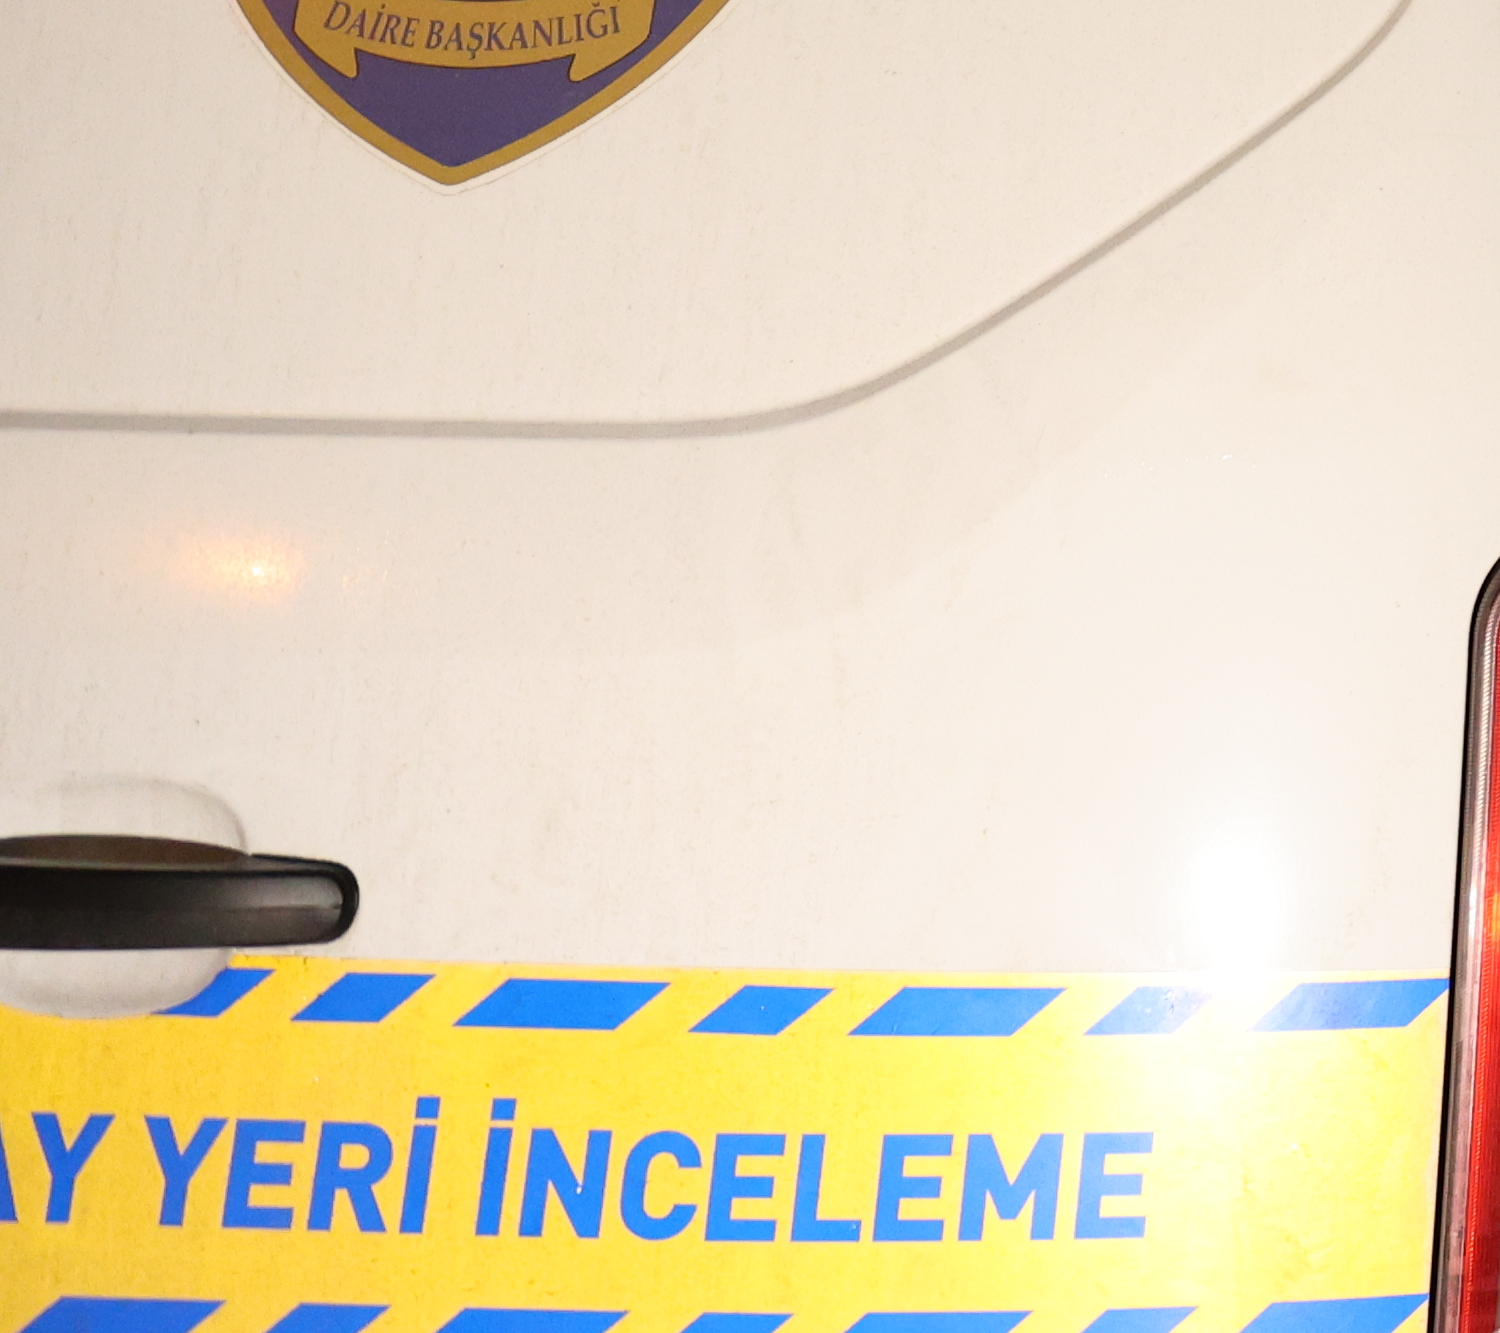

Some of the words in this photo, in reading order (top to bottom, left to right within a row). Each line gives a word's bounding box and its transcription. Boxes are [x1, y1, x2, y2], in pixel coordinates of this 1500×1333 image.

[323, 0, 421, 48] DAİRE
[425, 2, 621, 60] BAŞKANLIĞI
[0, 1112, 116, 1225] Y
[144, 1096, 441, 1235] YERİ
[475, 1098, 1155, 1243] İNCELEME
